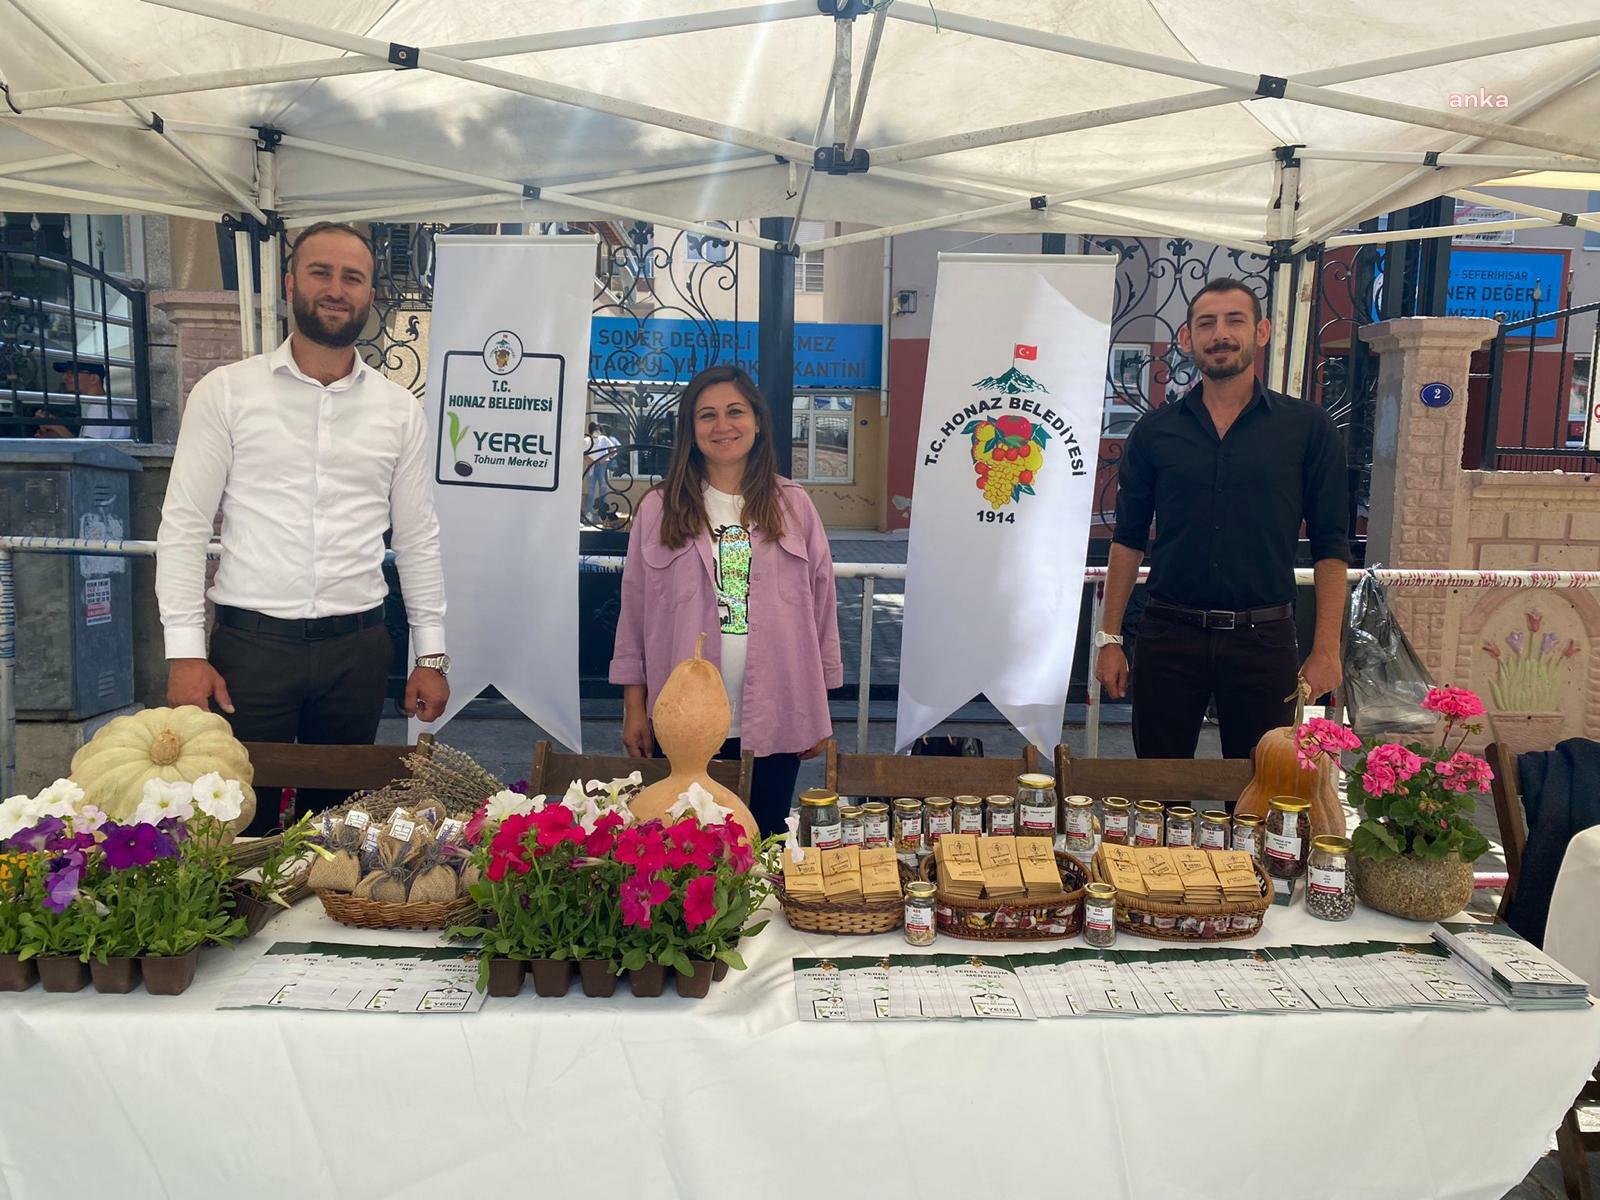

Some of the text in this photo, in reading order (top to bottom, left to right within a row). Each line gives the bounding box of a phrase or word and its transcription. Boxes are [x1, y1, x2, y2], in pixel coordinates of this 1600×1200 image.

[1461, 268, 1529, 281] SEFERİHİSAR
[598, 329, 664, 347] SONER
[670, 330, 752, 350] DEĞERLİ
[492, 380, 511, 393] T.C.
[1434, 388, 1441, 399] 2
[448, 395, 553, 412] HONAZ BELEDİYESİ
[472, 431, 553, 456] YEREL
[1008, 396, 1087, 477] BELEDİYESİ
[473, 454, 548, 468] Tohum Merkezi
[976, 510, 1016, 524] 1914
